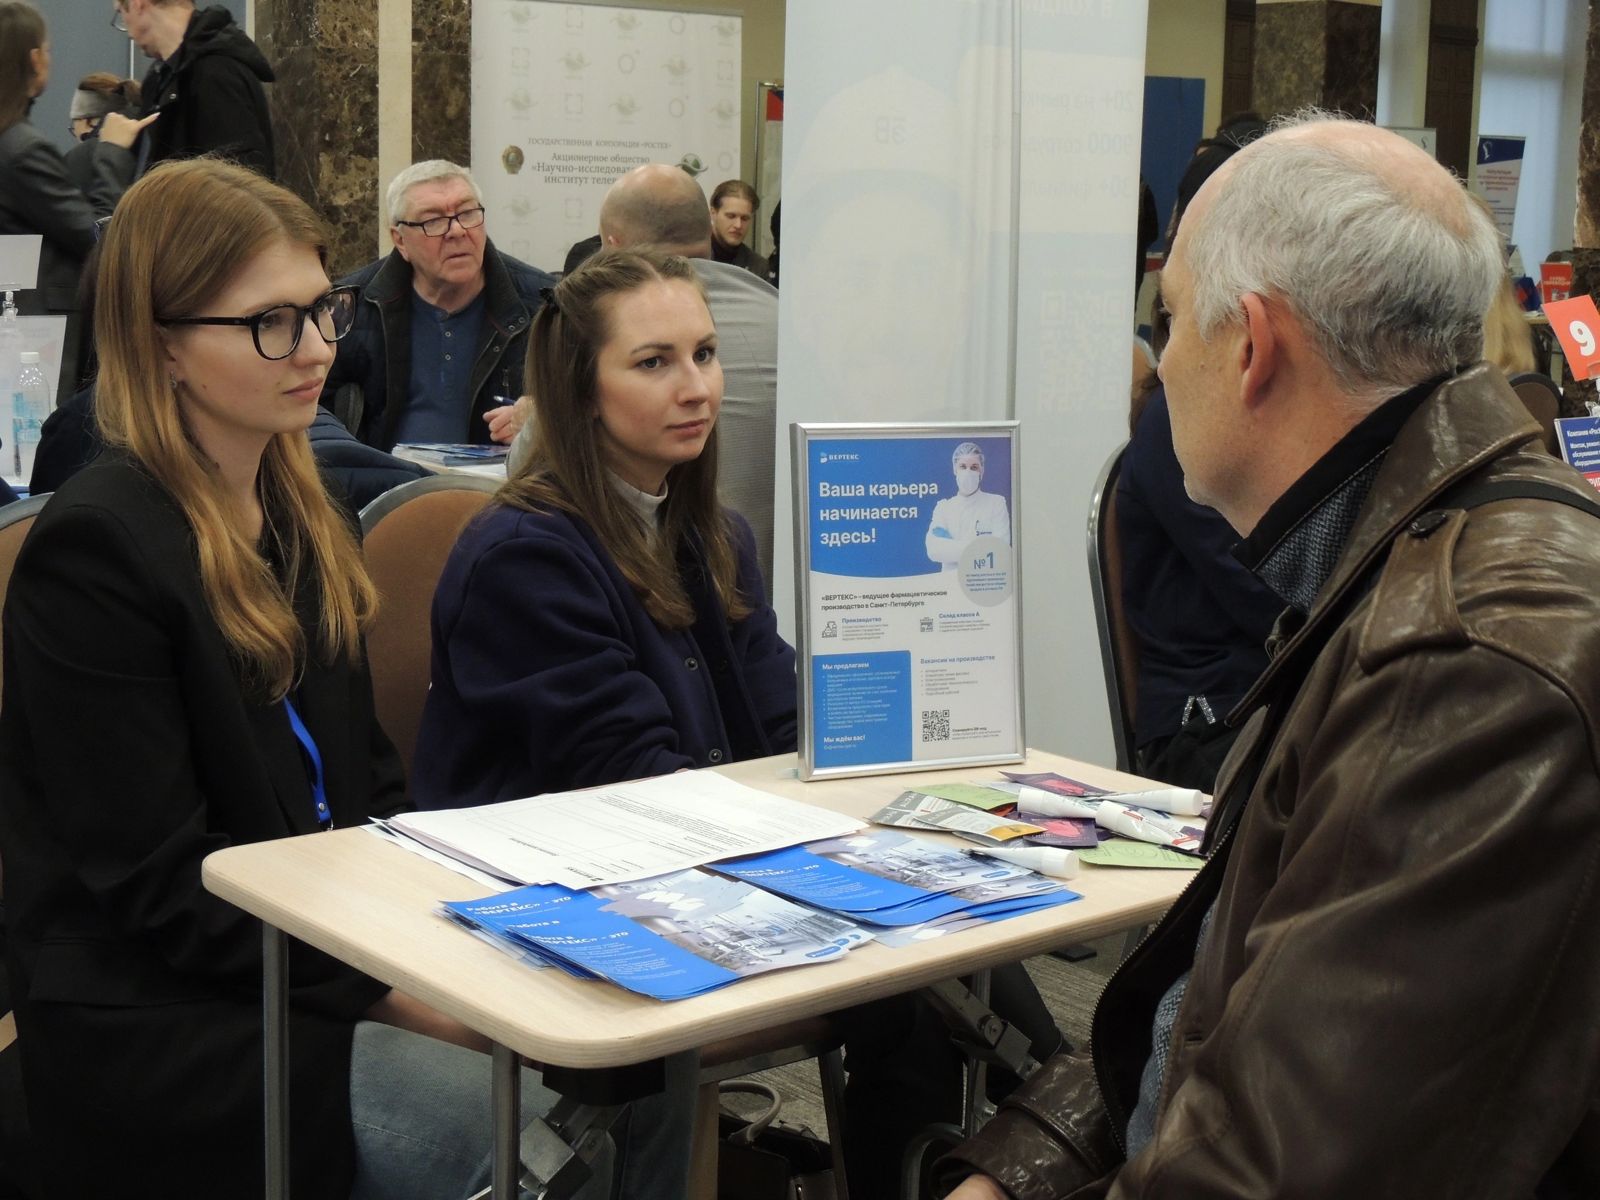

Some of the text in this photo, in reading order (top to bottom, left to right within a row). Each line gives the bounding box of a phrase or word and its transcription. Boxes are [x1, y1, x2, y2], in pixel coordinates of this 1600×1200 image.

[552, 152, 650, 164] Акционерное общество
[544, 175, 588, 187] институт
[1569, 320, 1596, 357] 9
[820, 482, 938, 499] Ваша карьера
[820, 507, 918, 521] начинается
[820, 528, 876, 547] здесь!
